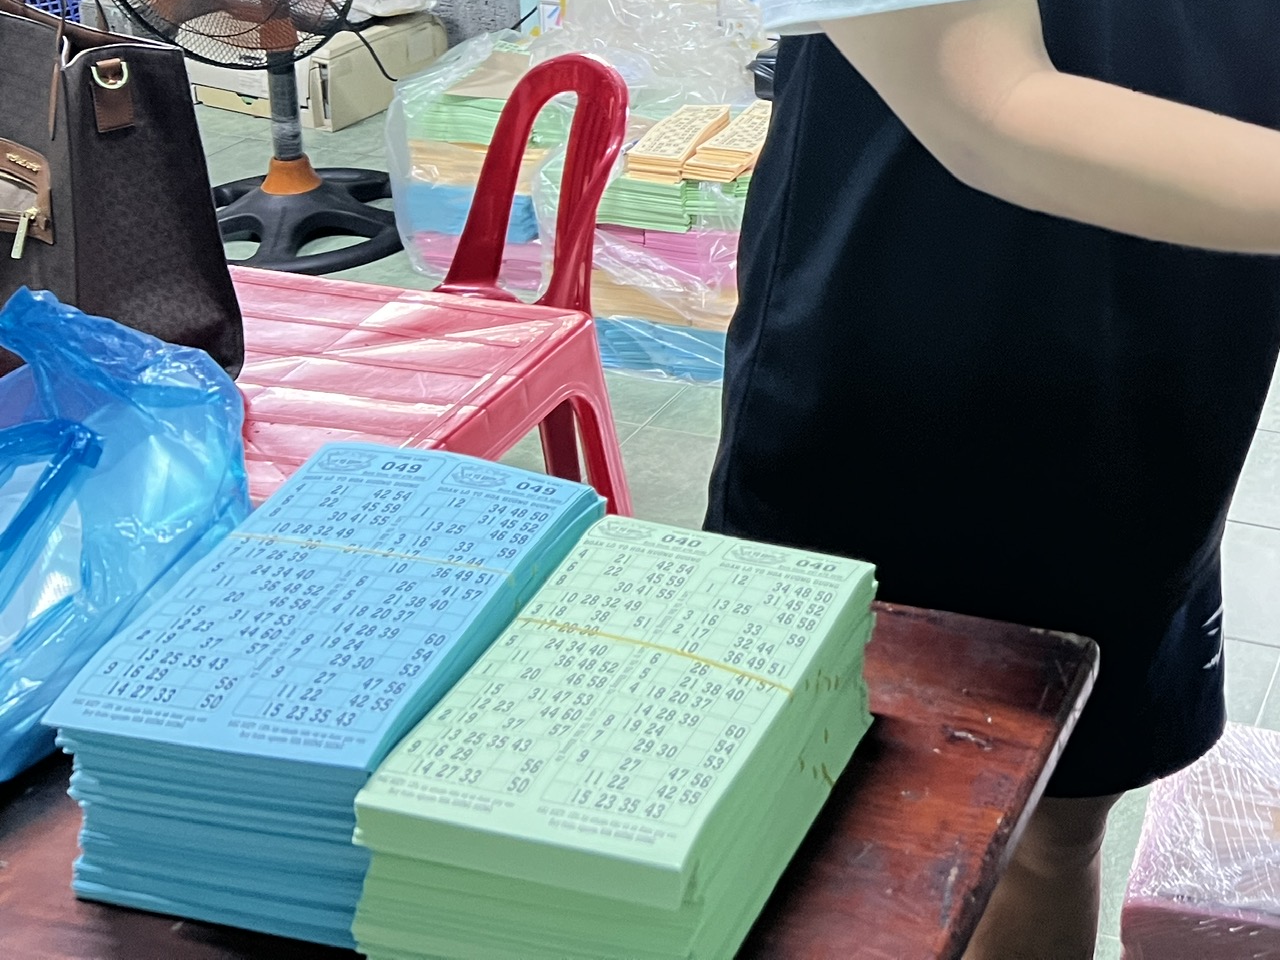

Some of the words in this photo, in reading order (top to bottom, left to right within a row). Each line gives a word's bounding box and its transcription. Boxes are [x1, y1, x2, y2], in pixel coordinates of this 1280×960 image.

[381, 461, 422, 473] 049
[296, 483, 306, 493] 4
[330, 485, 350, 495] 21
[373, 489, 392, 500] 42
[392, 491, 413, 501] 54
[516, 481, 557, 495] 049
[269, 507, 282, 517] 8
[327, 511, 348, 522] 30
[348, 513, 369, 523] 41
[369, 515, 390, 526] 55
[447, 497, 466, 508] 12
[488, 504, 507, 515] 34
[510, 508, 528, 518] 48
[529, 512, 549, 522] 50
[478, 515, 496, 525] 31
[500, 519, 519, 529] 45
[519, 522, 539, 533] 52
[393, 533, 406, 545] 3
[412, 535, 432, 548] 16
[454, 541, 474, 553] 33
[497, 547, 517, 559] 59
[661, 534, 702, 547] 040
[211, 561, 225, 573] 5
[250, 564, 272, 576] 24
[271, 566, 294, 578] 34
[296, 569, 315, 581] 40
[388, 562, 408, 574] 10
[431, 567, 453, 578] 36
[454, 570, 474, 582] 49
[474, 573, 494, 585] 51
[566, 561, 578, 572] 6
[603, 566, 623, 576] 22
[646, 573, 665, 584] 45
[666, 575, 685, 587] 59
[796, 559, 836, 572] 040
[223, 591, 245, 603] 20
[269, 596, 290, 608] 46
[289, 598, 311, 610] 58
[342, 589, 356, 601] 5
[383, 593, 403, 606] 21
[405, 596, 427, 608] 38
[429, 599, 449, 611] 40
[732, 574, 749, 585] 12
[772, 582, 791, 594] 34
[794, 587, 812, 598] 48
[814, 591, 833, 604] 50
[560, 592, 578, 603] 10
[580, 594, 600, 605] 28
[601, 597, 621, 608] 32
[624, 600, 642, 611] 49
[712, 599, 730, 610] 13
[732, 603, 752, 615] 25
[777, 612, 795, 625] 46
[797, 617, 816, 631] 58
[170, 618, 192, 630] 12
[192, 620, 214, 632] 23
[240, 626, 260, 637] 44
[260, 628, 283, 640] 60
[334, 621, 355, 634] 14
[355, 624, 377, 637] 28
[378, 627, 400, 639] 39
[424, 633, 446, 647] 60
[672, 623, 686, 638] 2
[691, 627, 710, 639] 17
[733, 636, 753, 650] 32
[757, 642, 775, 655] 44
[138, 648, 159, 661] 13
[159, 651, 183, 665] 25
[182, 655, 206, 668] 35
[206, 657, 229, 671] 43
[511, 649, 532, 662] 11
[554, 655, 576, 667] 36
[578, 658, 597, 670] 48
[598, 661, 619, 673] 52
[108, 681, 130, 696] 14
[130, 684, 154, 699] 27
[153, 687, 176, 703] 33
[200, 694, 223, 709] 50
[277, 684, 298, 699] 11
[299, 687, 323, 702] 22
[349, 694, 370, 708] 42
[370, 697, 394, 712] 55
[484, 683, 504, 696] 15
[528, 687, 548, 701] 31
[552, 691, 573, 703] 47
[572, 693, 594, 706] 53
[629, 682, 640, 693] 4
[647, 685, 666, 699] 18
[668, 691, 689, 704] 20
[691, 696, 713, 709] 37
[438, 708, 452, 720] 2
[457, 711, 478, 724] 19
[502, 717, 525, 730] 37
[548, 724, 571, 736] 57
[602, 714, 615, 727] 8
[622, 718, 642, 732] 19
[644, 723, 666, 737] 24
[714, 739, 735, 755] 54
[407, 740, 422, 753] 9
[427, 744, 449, 757] 16
[450, 747, 473, 761] 29
[520, 758, 543, 774] 56
[576, 749, 590, 762] 9
[619, 757, 642, 772] 27
[669, 768, 690, 781] 47
[690, 773, 712, 788] 56
[413, 759, 435, 775] 14
[435, 764, 459, 779] 27
[458, 768, 482, 782] 33
[507, 776, 530, 790] 50
[571, 788, 594, 805] 15
[594, 793, 617, 809] 23
[618, 797, 641, 814] 35
[645, 803, 665, 819] 43
